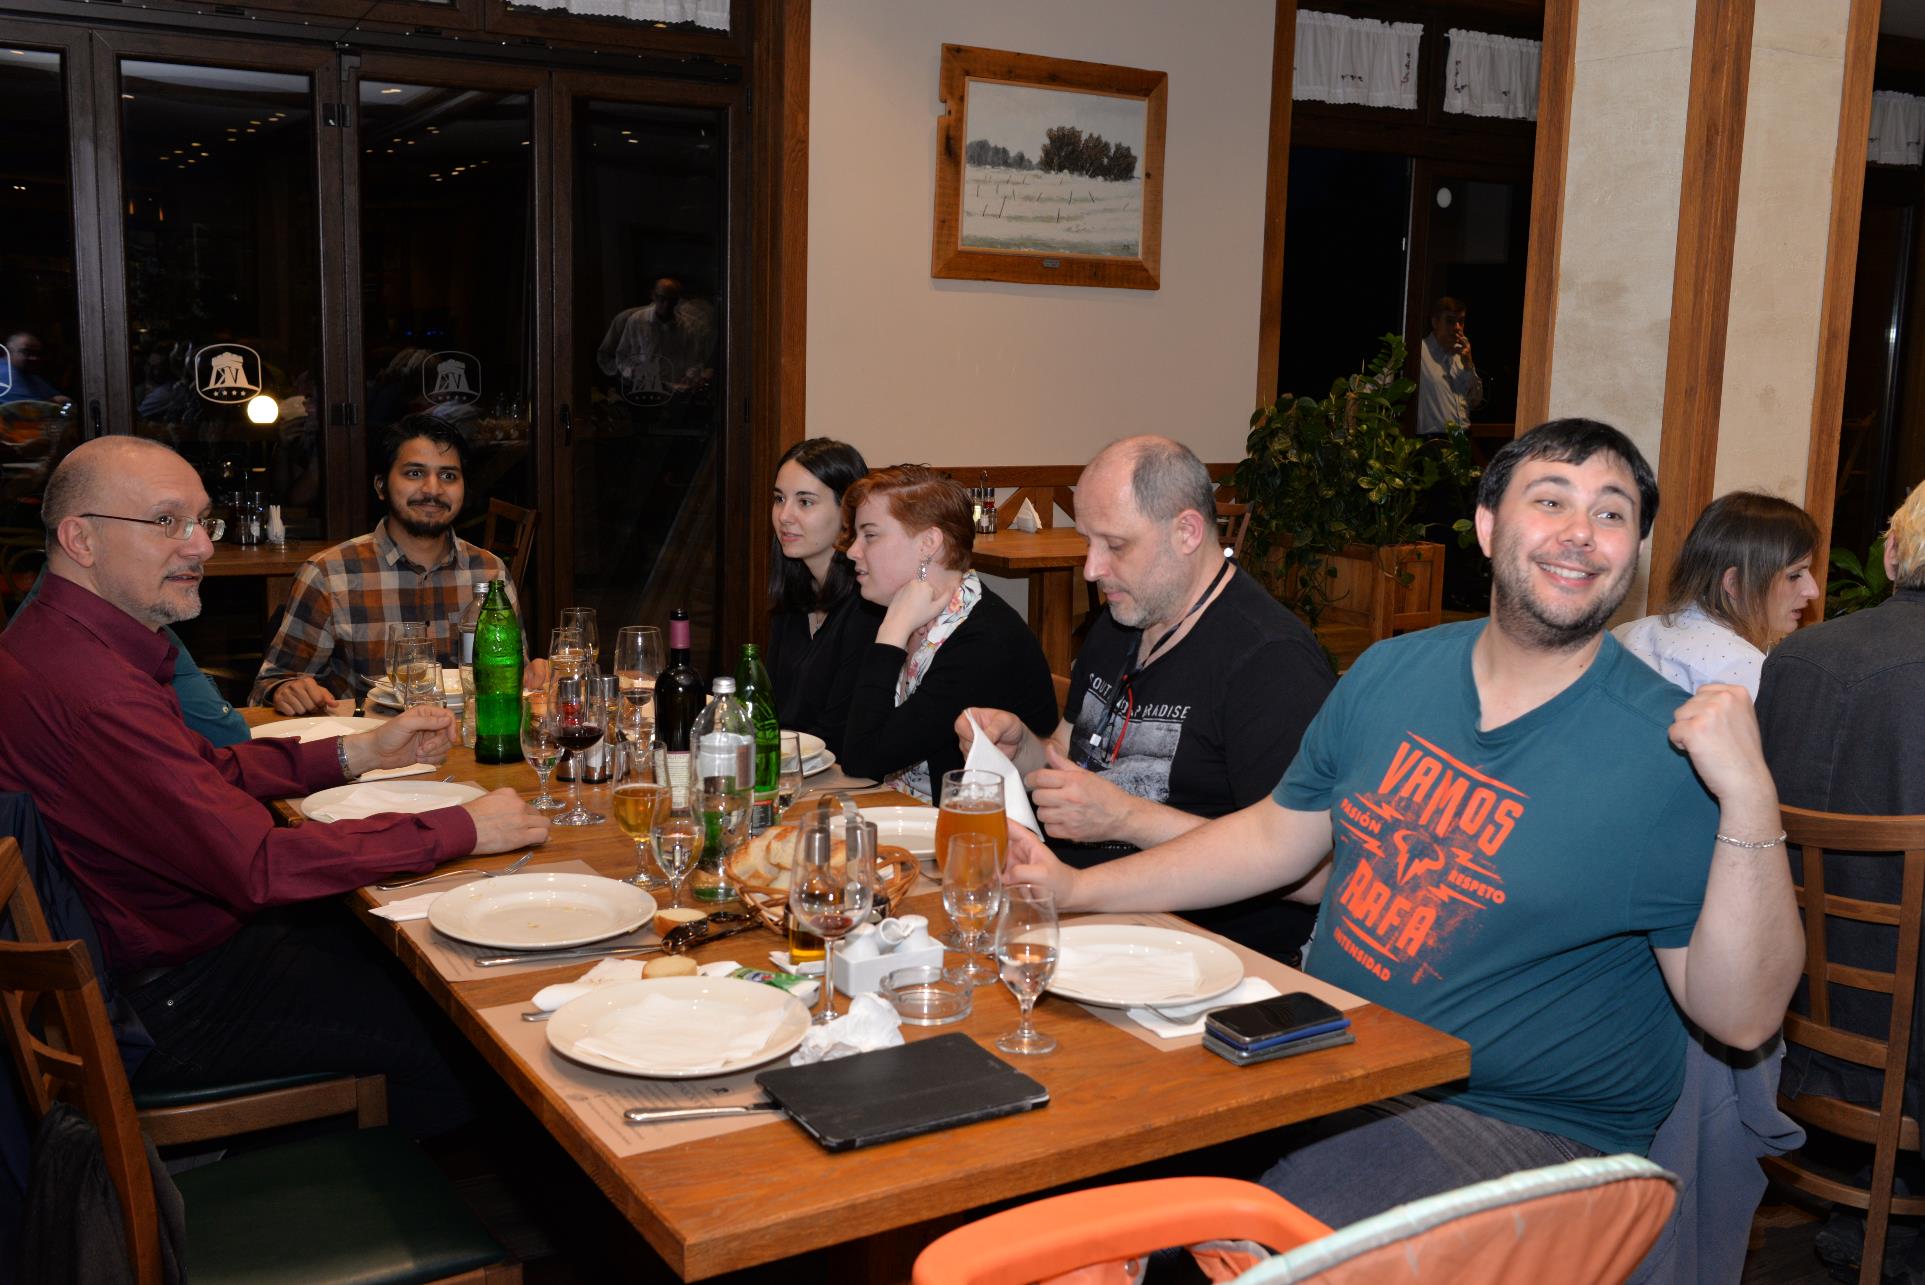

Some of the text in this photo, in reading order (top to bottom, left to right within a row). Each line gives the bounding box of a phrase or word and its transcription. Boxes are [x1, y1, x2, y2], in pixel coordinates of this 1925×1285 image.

[1377, 741, 1525, 856] VAMOS
[1340, 858, 1437, 957] RAFA
[1447, 869, 1506, 904] RESPETO
[1333, 927, 1391, 982] INTENSIDAD
